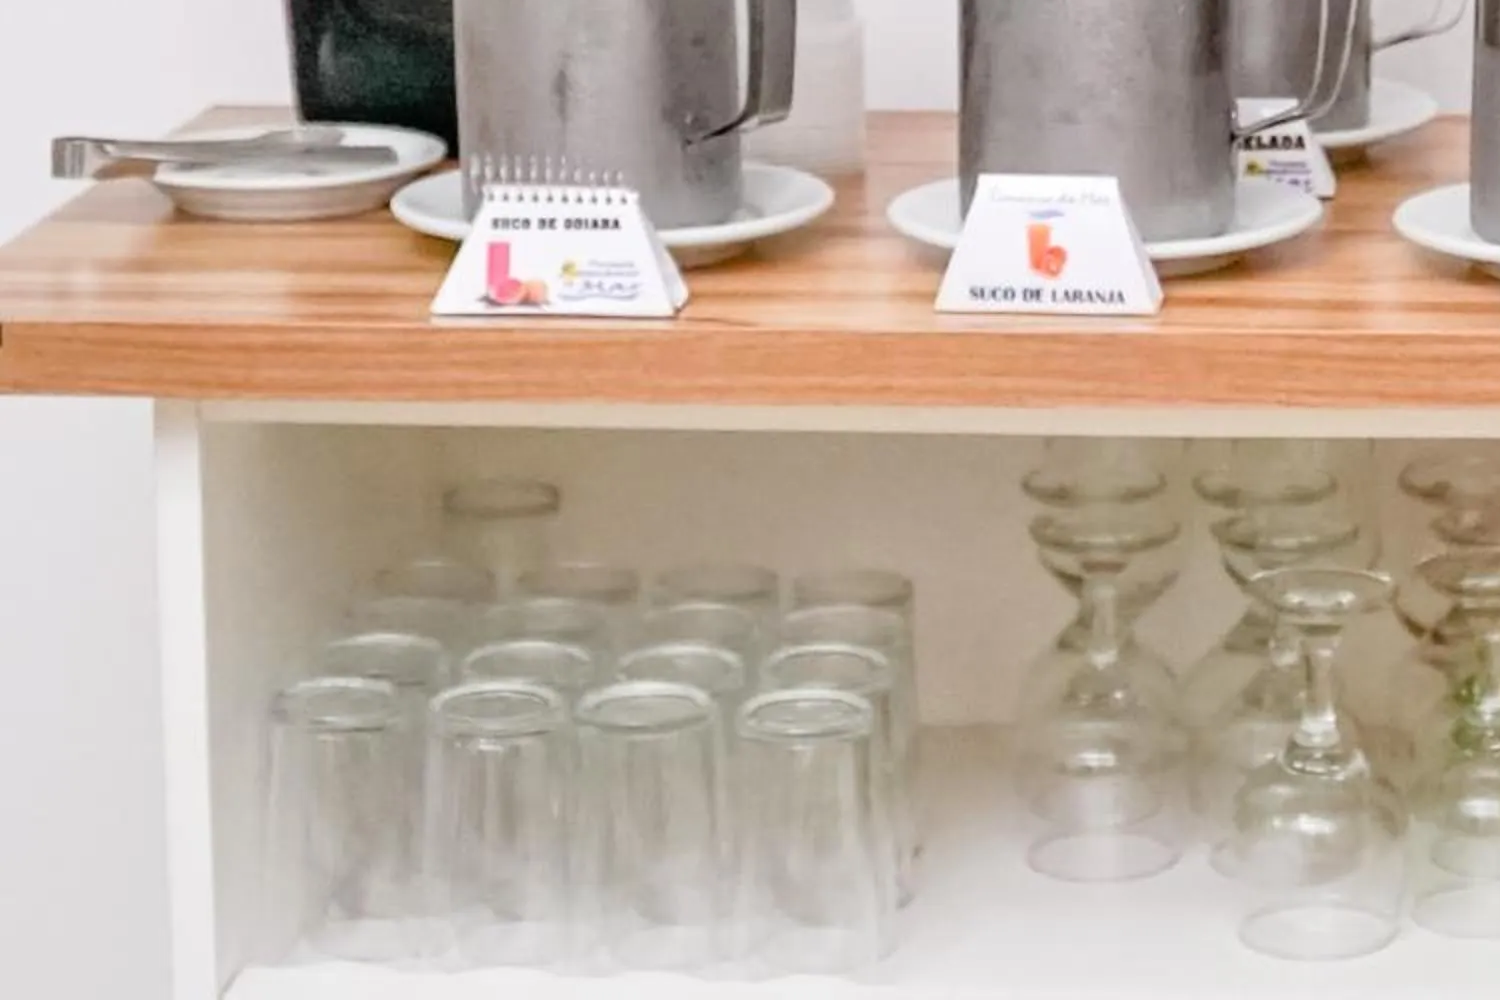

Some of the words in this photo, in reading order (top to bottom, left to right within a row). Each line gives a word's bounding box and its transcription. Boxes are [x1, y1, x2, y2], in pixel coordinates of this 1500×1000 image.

[537, 217, 558, 231] DE
[969, 286, 1016, 302] SUCO
[1022, 286, 1043, 303] DE
[1050, 289, 1126, 304] LARANJA
